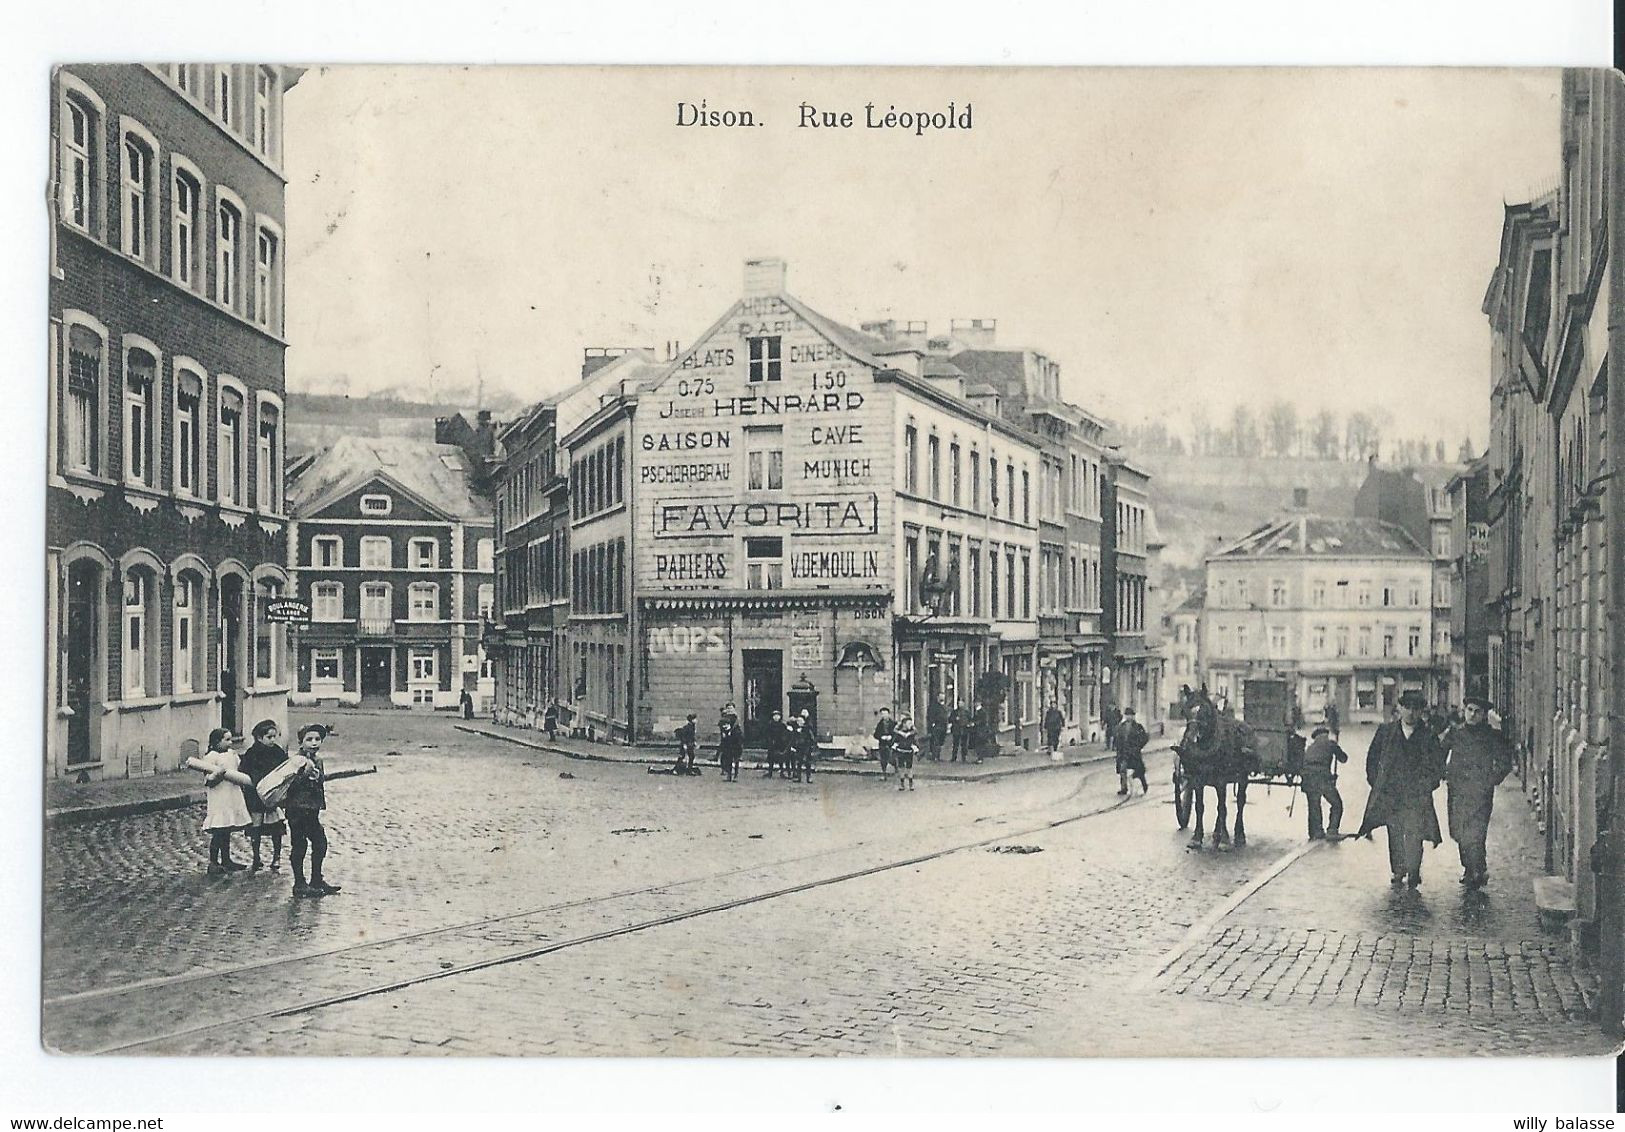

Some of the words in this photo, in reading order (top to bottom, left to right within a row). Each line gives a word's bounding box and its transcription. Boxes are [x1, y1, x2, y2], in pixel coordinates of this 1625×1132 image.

[682, 349, 734, 370] PLATS
[678, 378, 715, 396] 0.75
[812, 370, 846, 390] 1.50
[714, 392, 864, 417] HENRARD
[642, 431, 730, 450] SAISON
[811, 425, 863, 445] CAVE
[804, 459, 872, 480] MUNICH
[662, 501, 865, 531] FAVORITA
[656, 553, 728, 580] PAPIERS
[854, 608, 886, 620] DISON
